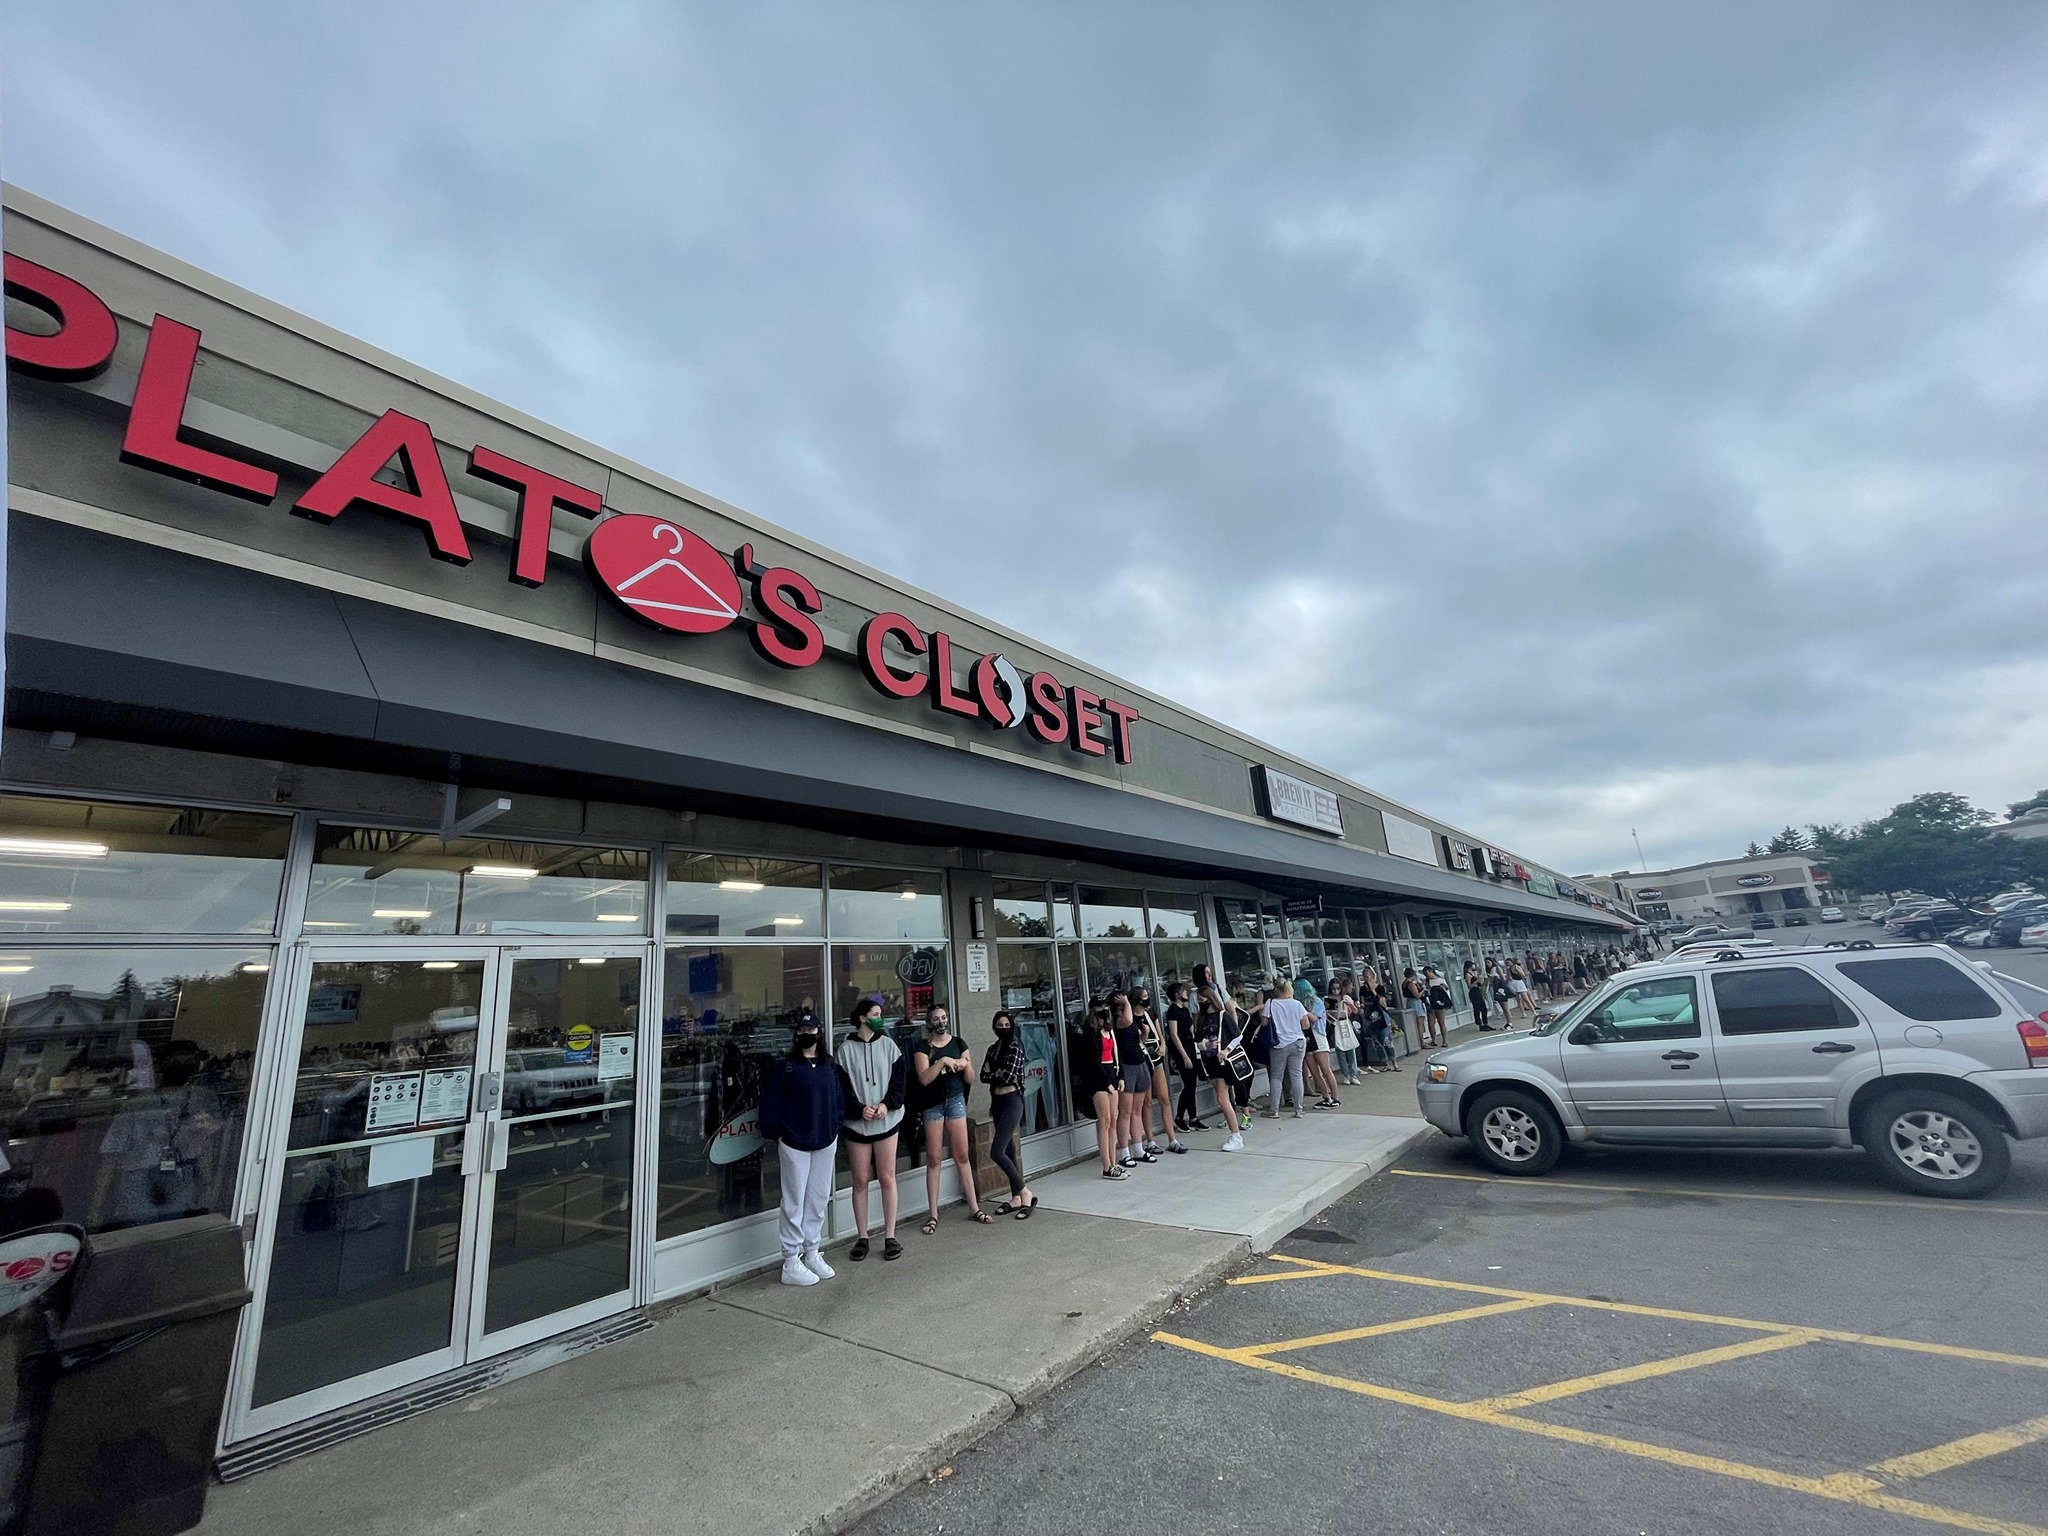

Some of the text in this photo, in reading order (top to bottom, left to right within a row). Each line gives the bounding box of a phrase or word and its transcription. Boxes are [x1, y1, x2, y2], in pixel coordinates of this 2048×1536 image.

[857, 611, 1139, 766] CLOSET
[1276, 778, 1313, 808] BREW IT
[901, 957, 935, 975] OPEN
[974, 960, 981, 971] 15
